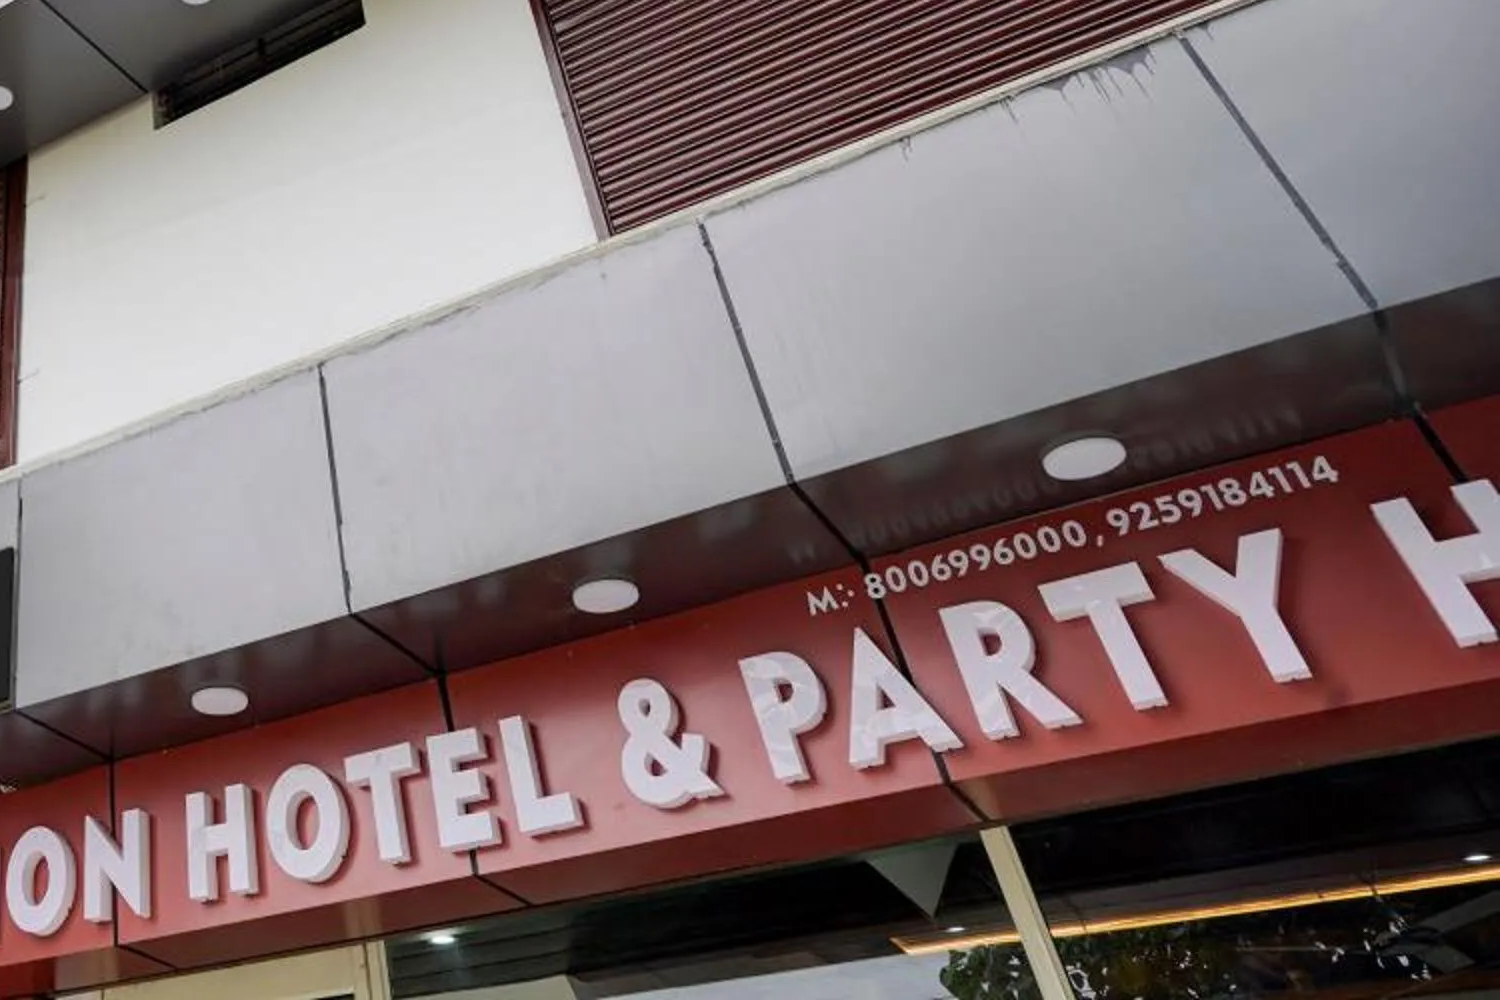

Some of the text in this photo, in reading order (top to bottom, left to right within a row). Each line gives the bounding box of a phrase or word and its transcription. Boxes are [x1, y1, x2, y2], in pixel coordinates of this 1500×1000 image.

[1106, 455, 1338, 536] 9259184114
[185, 714, 583, 904] HOTEL
[617, 677, 725, 810] &
[738, 527, 1313, 786] PARTY
